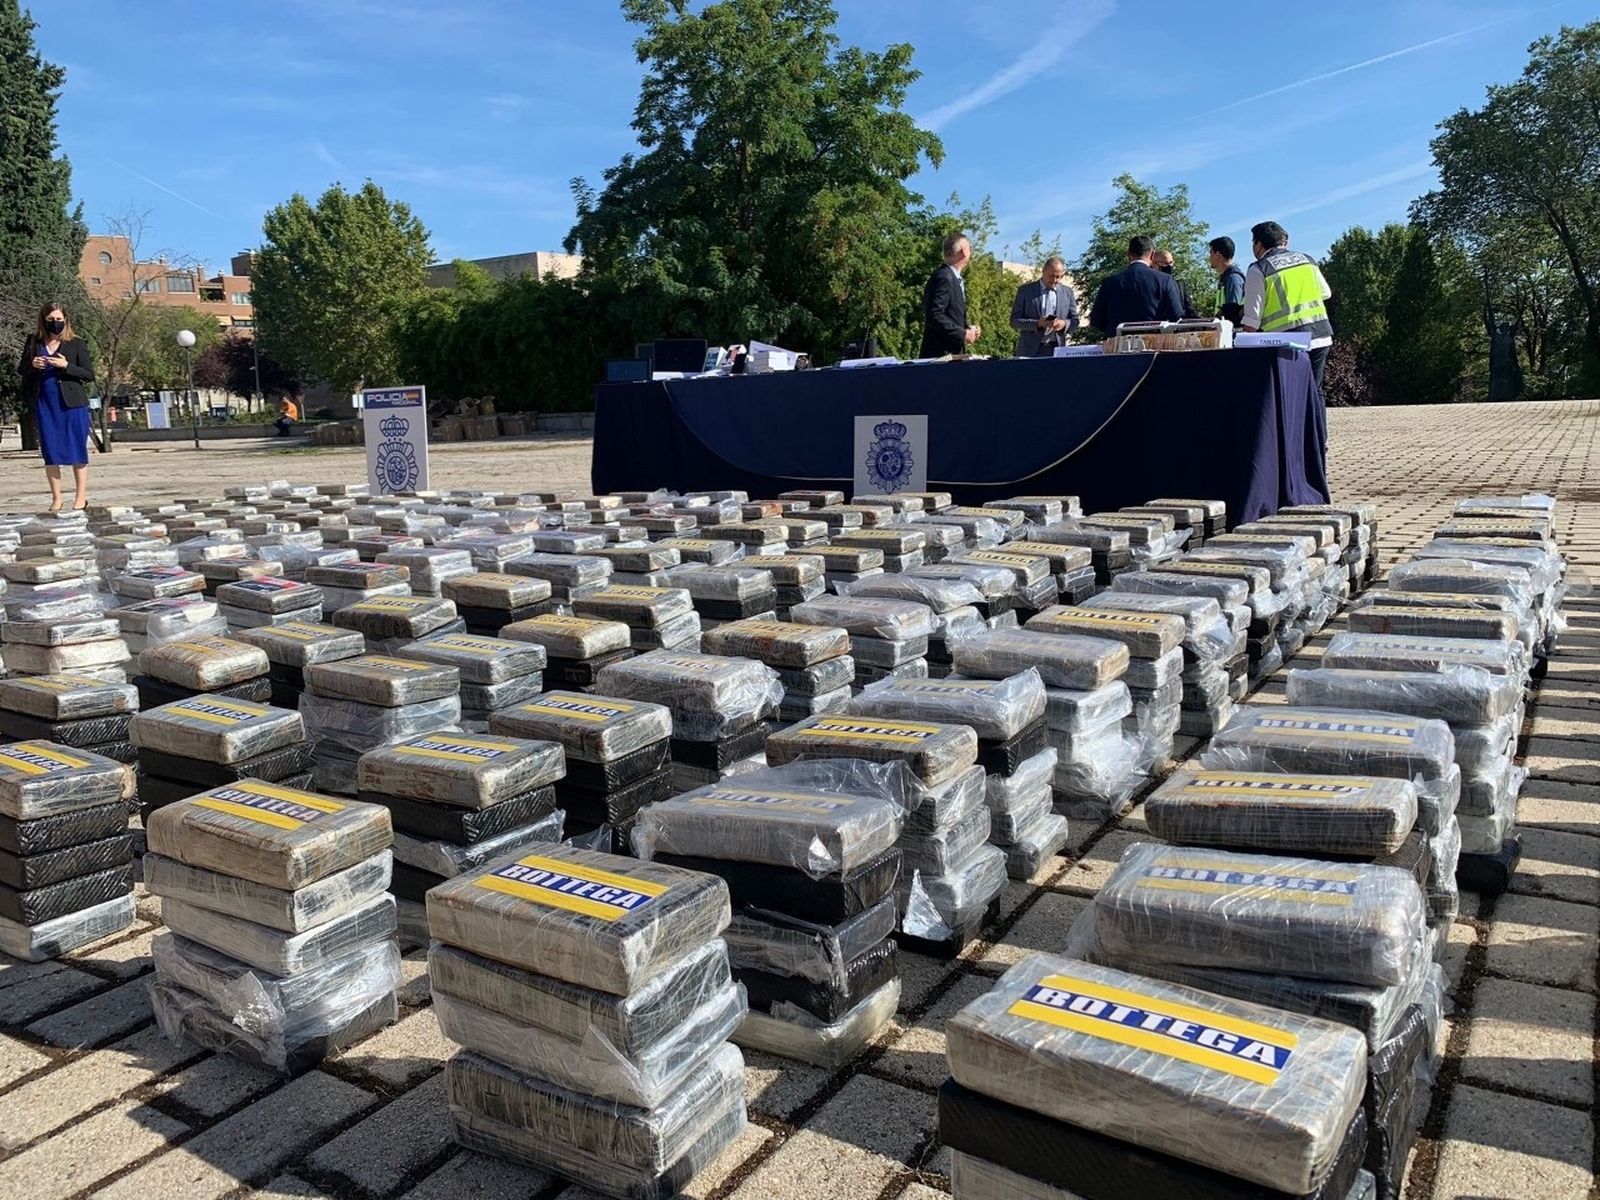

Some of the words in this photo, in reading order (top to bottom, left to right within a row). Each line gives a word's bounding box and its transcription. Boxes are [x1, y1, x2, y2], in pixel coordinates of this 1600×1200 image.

[1259, 719, 1409, 736] BOTTEGA
[409, 740, 503, 757] BOTTEGA
[214, 789, 322, 822] BOTTEGA
[499, 864, 643, 908] BOTTEGA
[1149, 867, 1348, 893] BOTTEGA
[1031, 986, 1277, 1066] BOTTEGA
